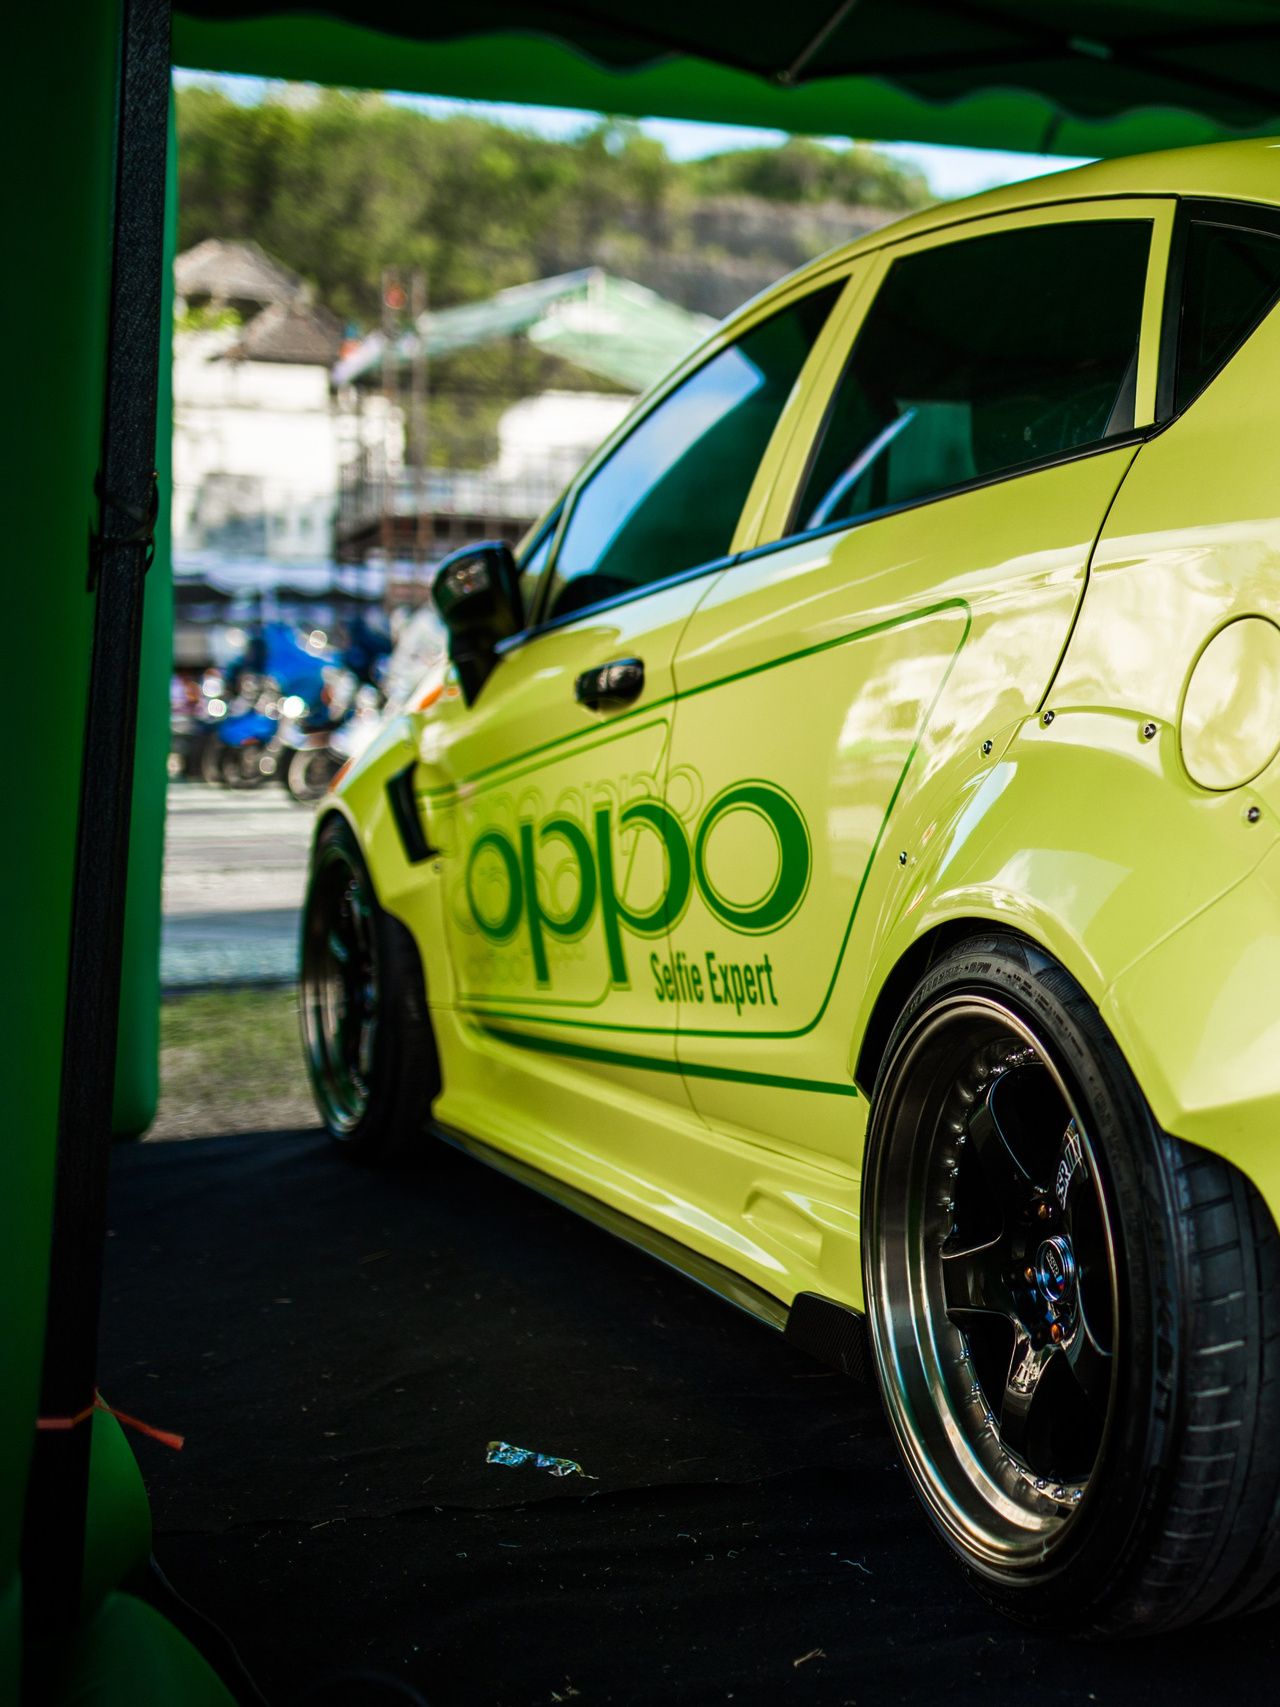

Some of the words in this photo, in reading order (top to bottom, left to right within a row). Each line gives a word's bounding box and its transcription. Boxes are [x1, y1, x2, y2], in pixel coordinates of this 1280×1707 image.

[466, 782, 813, 990] oppo
[650, 951, 705, 1003] Selfie
[705, 951, 778, 1017] Expert
